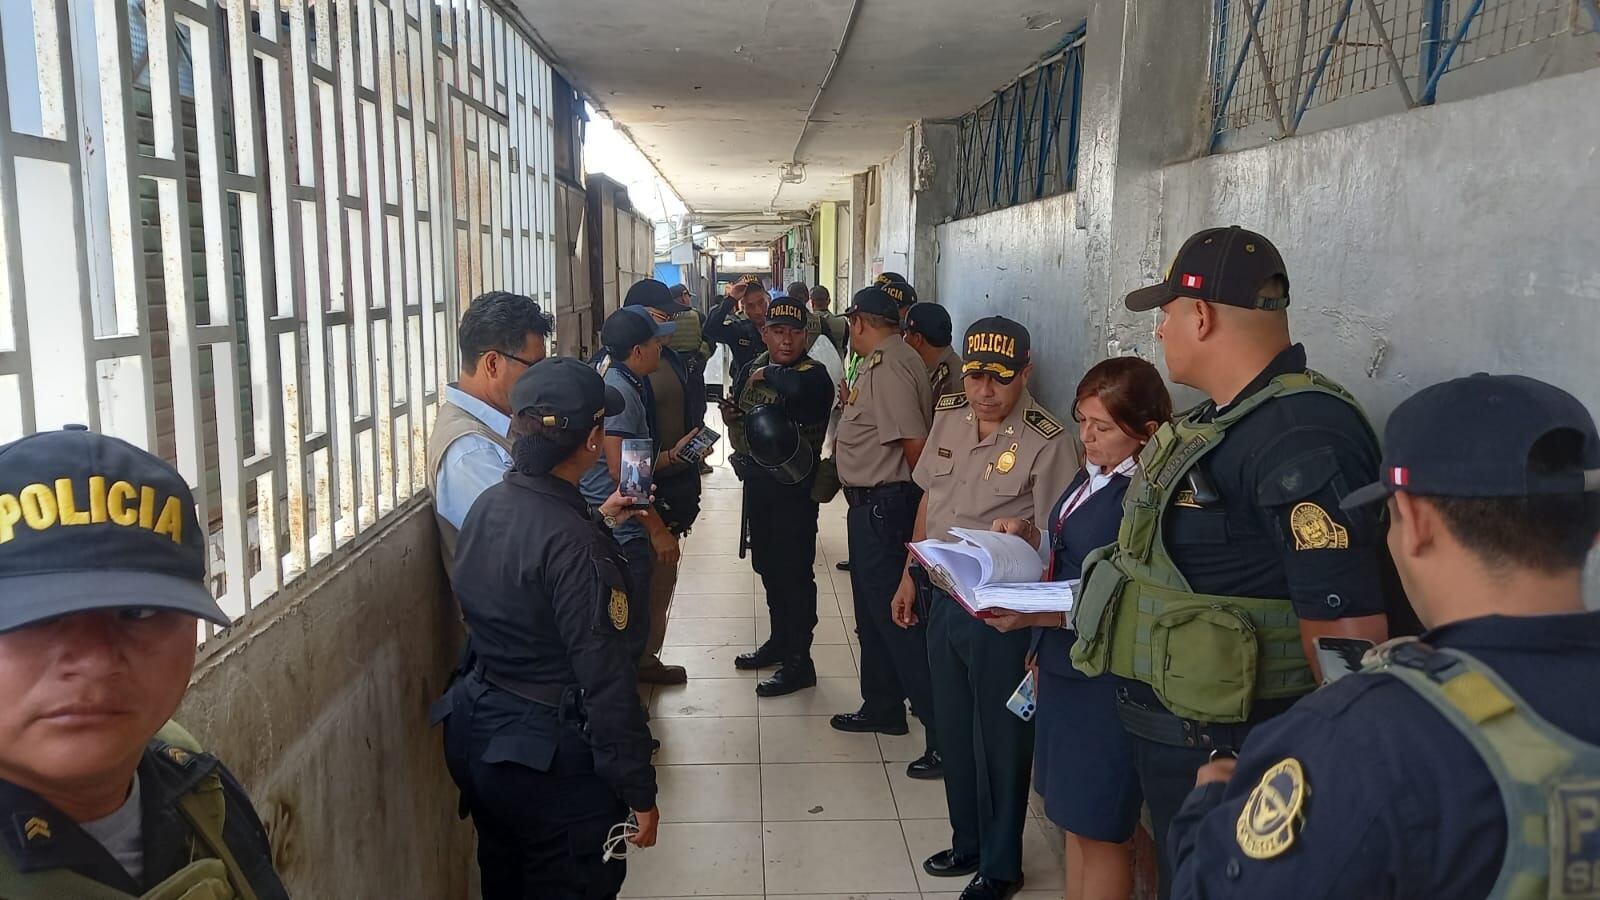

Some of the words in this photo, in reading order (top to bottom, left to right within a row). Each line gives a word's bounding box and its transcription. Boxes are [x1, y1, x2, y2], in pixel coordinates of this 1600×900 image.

[770, 304, 802, 321] POLICIA
[967, 332, 1015, 358] POLICIA
[0, 475, 182, 545] POLICIA
